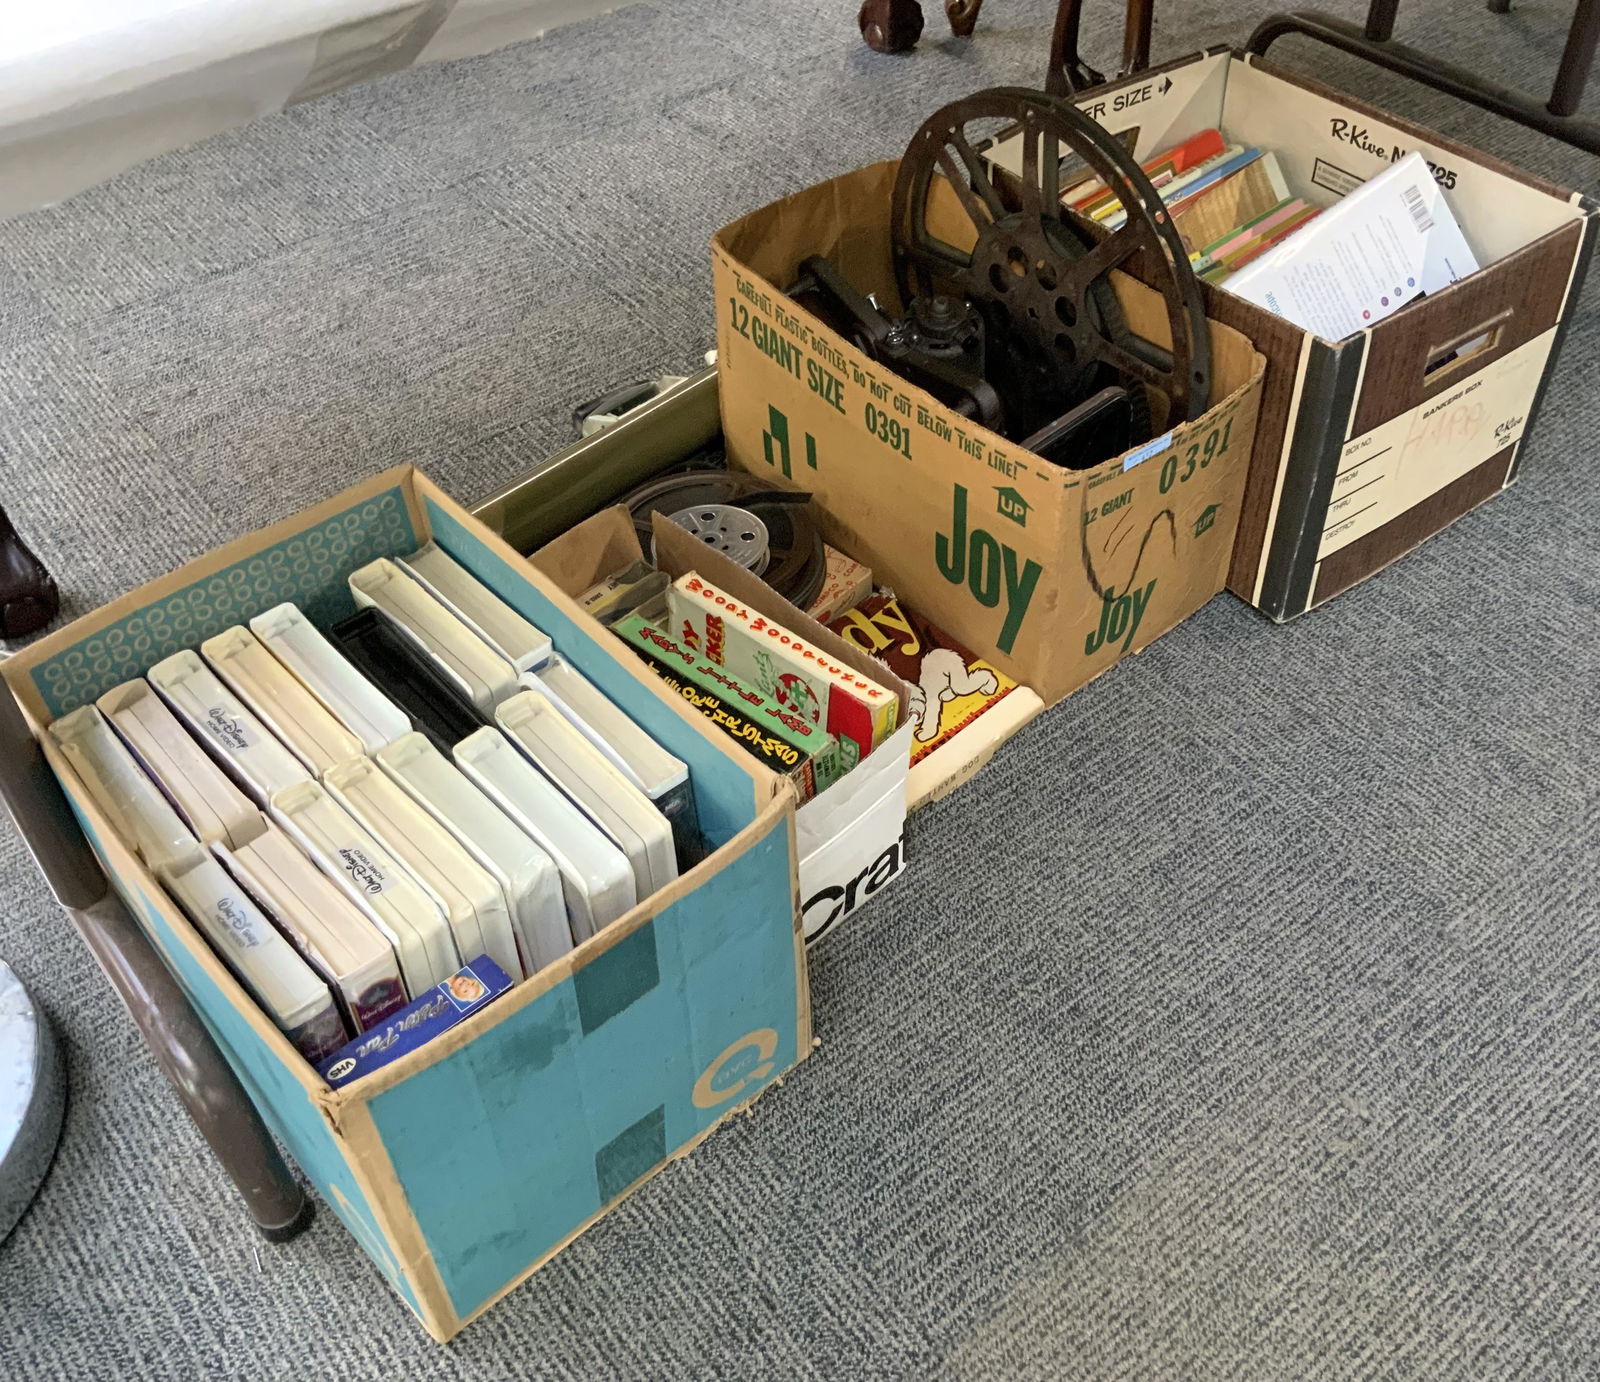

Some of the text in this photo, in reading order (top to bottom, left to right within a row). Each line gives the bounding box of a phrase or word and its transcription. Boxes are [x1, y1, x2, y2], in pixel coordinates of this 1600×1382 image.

[1113, 84, 1153, 112] SIZE
[1330, 118, 1385, 158] R-Kive
[729, 297, 750, 340] 12
[751, 315, 803, 380] GIANT
[807, 357, 846, 415] SIZE
[865, 402, 913, 461] 0391
[736, 277, 772, 317] CAREFUL!
[775, 308, 808, 344] PLASTIC
[853, 368, 866, 388] DO
[869, 379, 889, 403] NOT
[893, 395, 913, 418] CUT
[917, 410, 953, 443] BELOW
[957, 434, 982, 461] THIS
[987, 450, 1018, 481] LINE!
[1422, 379, 1484, 420] BANKERS BOX
[1159, 415, 1234, 495] 0391
[1345, 444, 1360, 457] BOX
[1337, 469, 1360, 487] FROM
[1000, 498, 1026, 518] UP
[1083, 487, 1136, 527] 12 GIANT
[1332, 498, 1352, 512] THRU
[1325, 519, 1356, 541] DESTROY
[686, 577, 884, 699] WOODY WOODPECKER
[696, 666, 765, 707] LITTLE
[764, 707, 813, 737] LAMB
[702, 707, 799, 766] CHRISTMAS
[394, 993, 449, 1032] Peter
[355, 1026, 400, 1059] Pan
[329, 1060, 354, 1079] VHS
